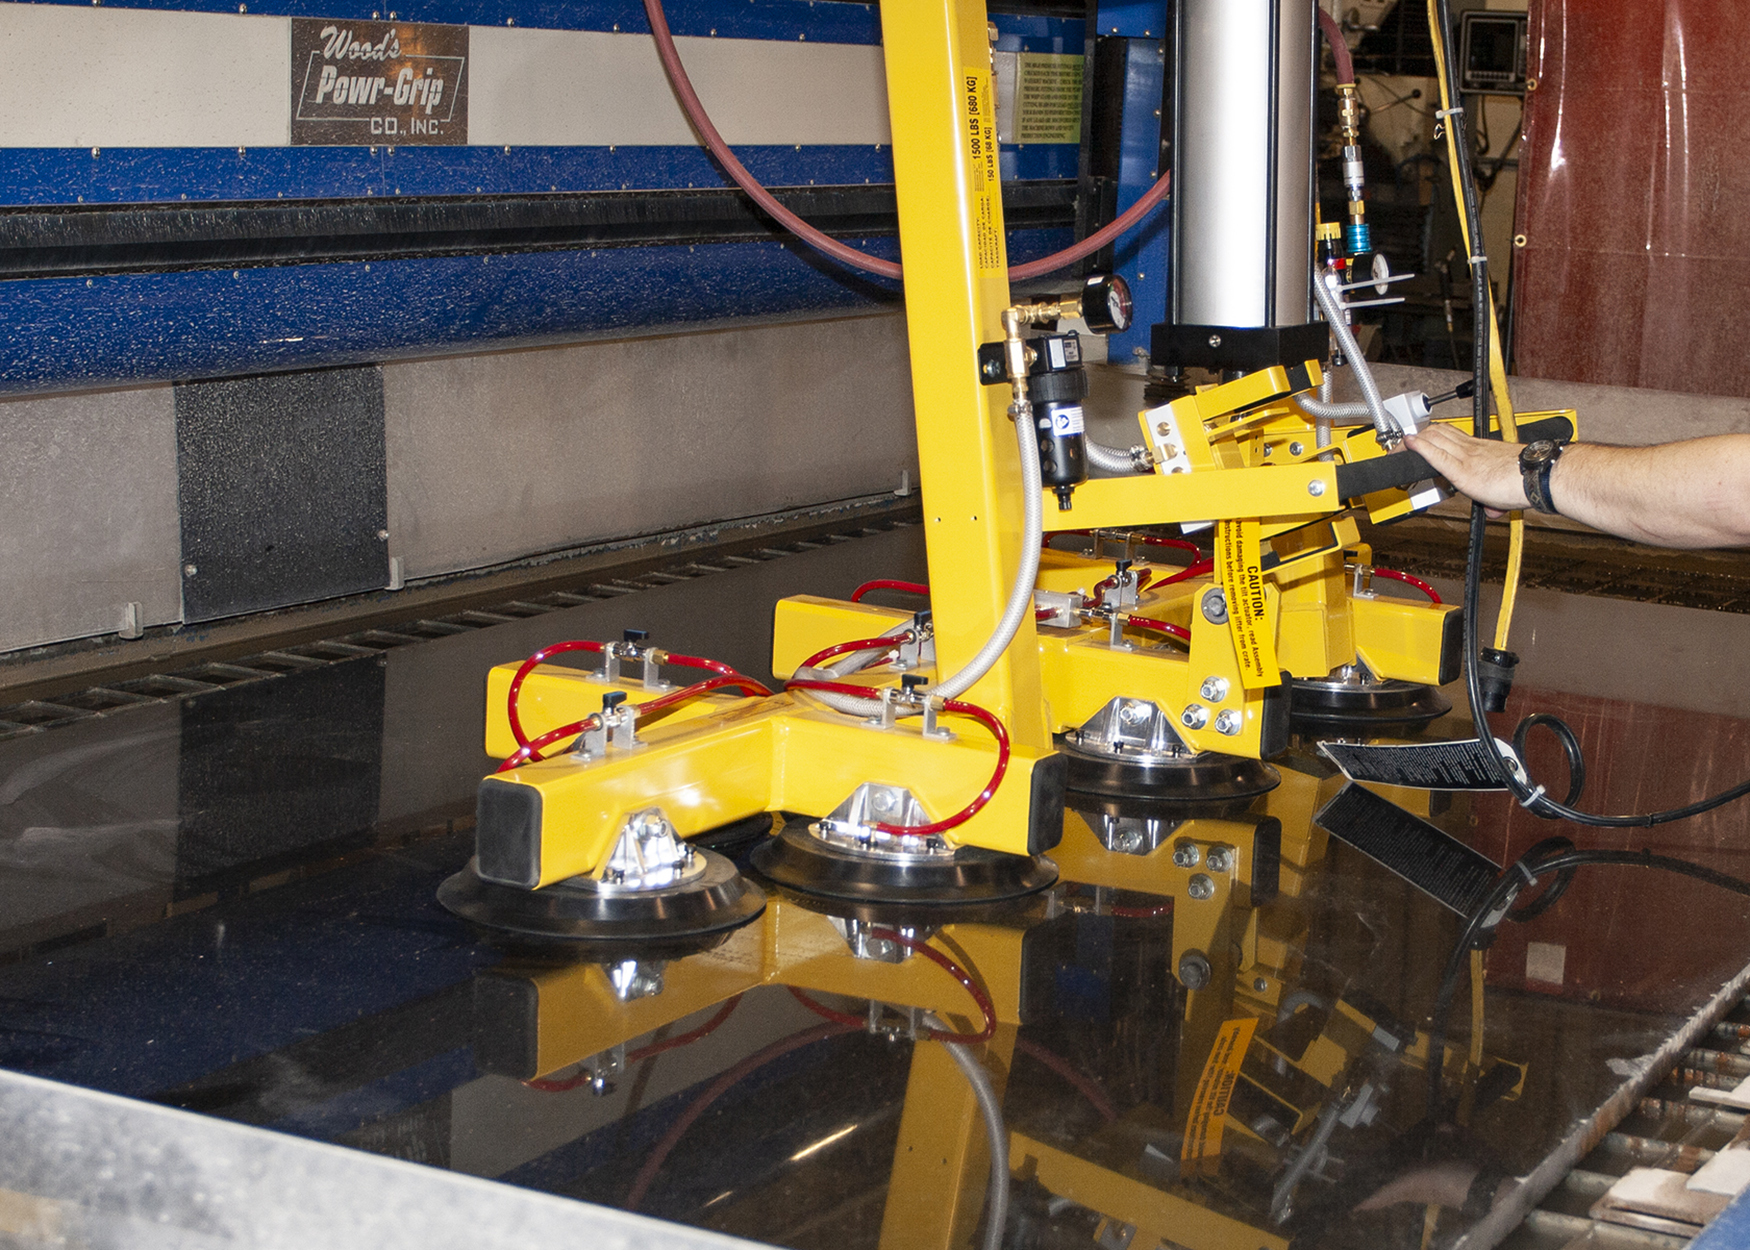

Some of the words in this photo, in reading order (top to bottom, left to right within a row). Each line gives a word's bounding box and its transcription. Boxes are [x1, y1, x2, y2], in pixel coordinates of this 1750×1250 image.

[320, 25, 402, 61] Wood's
[315, 65, 444, 115] Powr-Grip
[966, 76, 978, 93] KG]
[968, 95, 980, 115] [680
[411, 117, 444, 135] INC.
[969, 118, 979, 135] LBS
[984, 126, 993, 140] KG]
[971, 138, 981, 160] 1500
[986, 154, 994, 168] LBS
[987, 169, 995, 182] 150
[1235, 520, 1244, 539] avoid
[1235, 540, 1245, 573] damaging
[1226, 561, 1234, 583] before
[1229, 584, 1239, 615] removing
[1240, 586, 1248, 597] tilt
[1247, 566, 1265, 621] CAUTION:
[1234, 615, 1244, 633] lifter
[1238, 634, 1247, 650] from
[1248, 630, 1258, 646] read
[1242, 650, 1251, 671] crate.
[1252, 646, 1264, 677] Assembly
